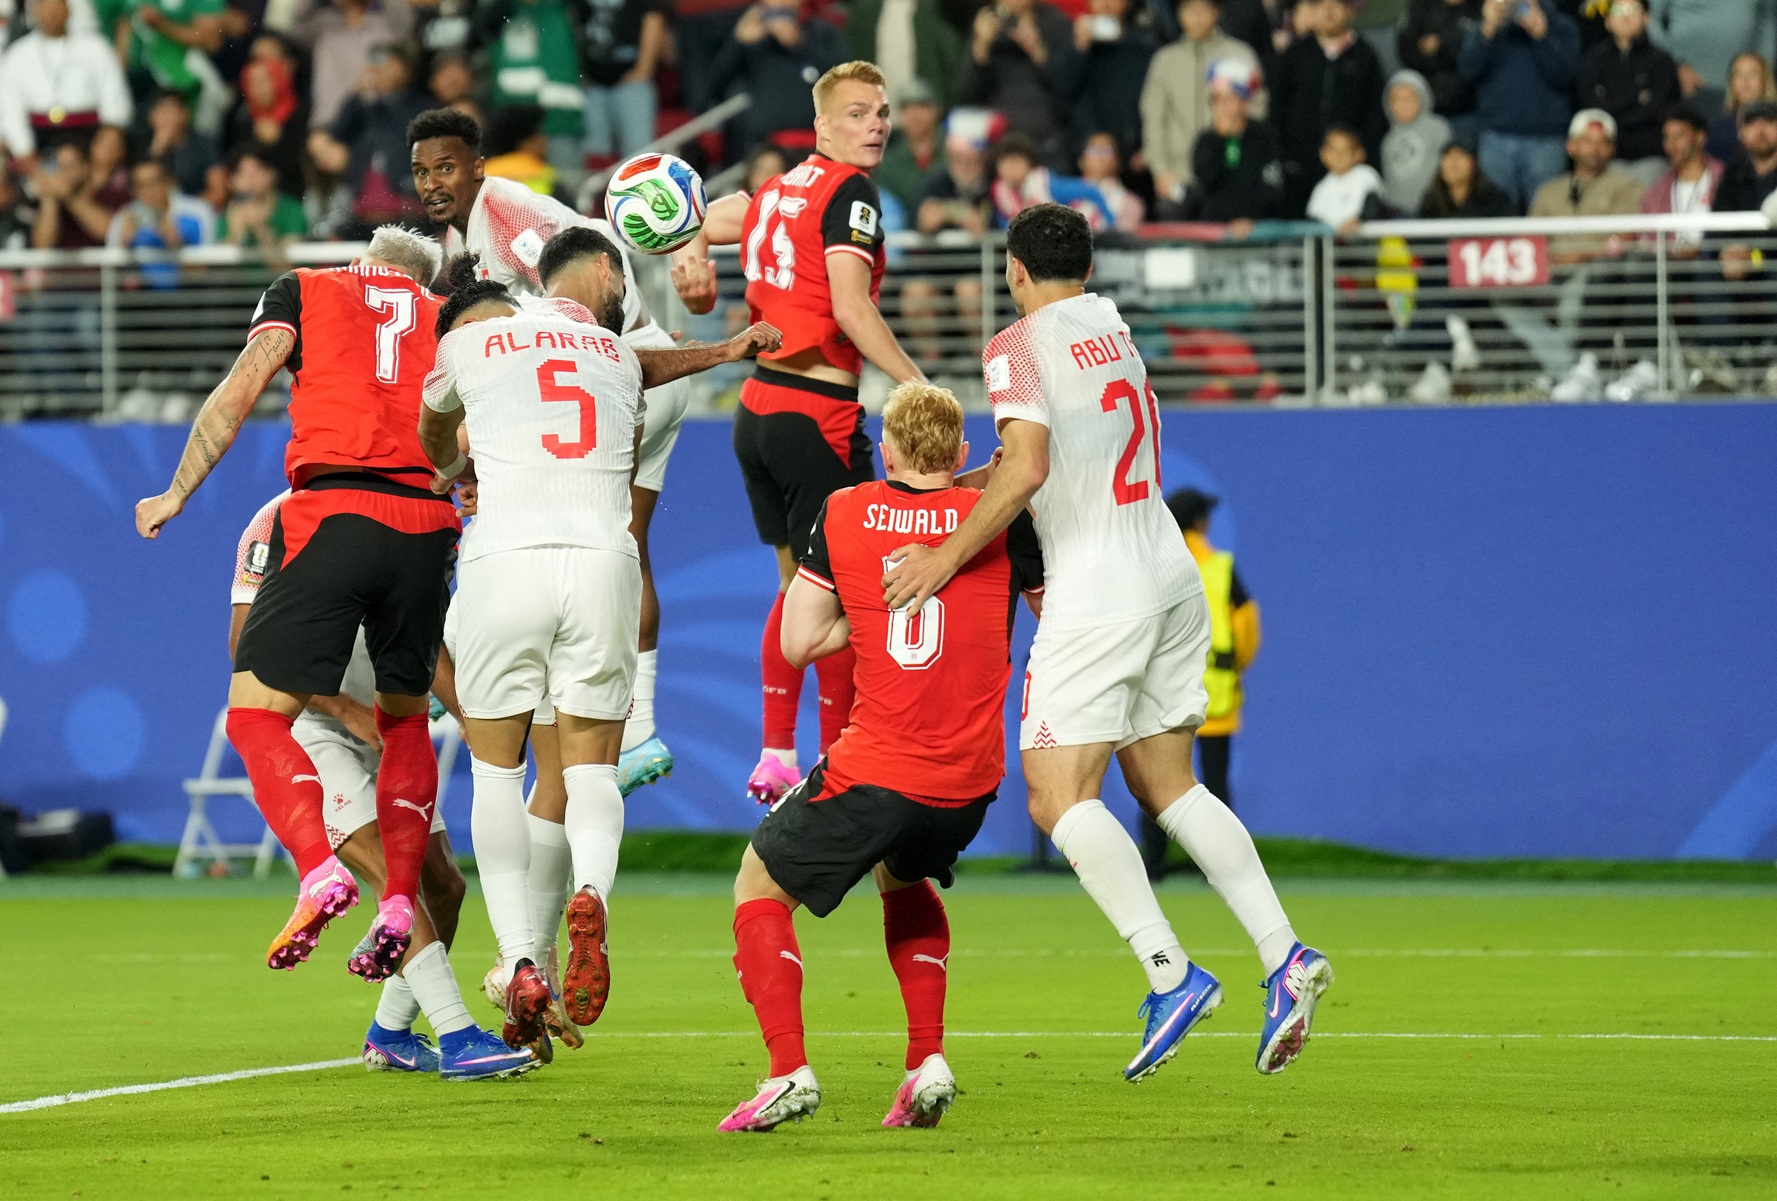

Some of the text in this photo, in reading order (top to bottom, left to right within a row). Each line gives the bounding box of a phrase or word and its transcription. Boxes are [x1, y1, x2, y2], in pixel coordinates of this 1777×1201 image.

[744, 189, 807, 292] 15
[1459, 238, 1537, 287] 143
[365, 283, 419, 383] 7
[1070, 333, 1122, 370] ABU
[536, 358, 597, 459] 5
[863, 503, 958, 535] SEIWALD
